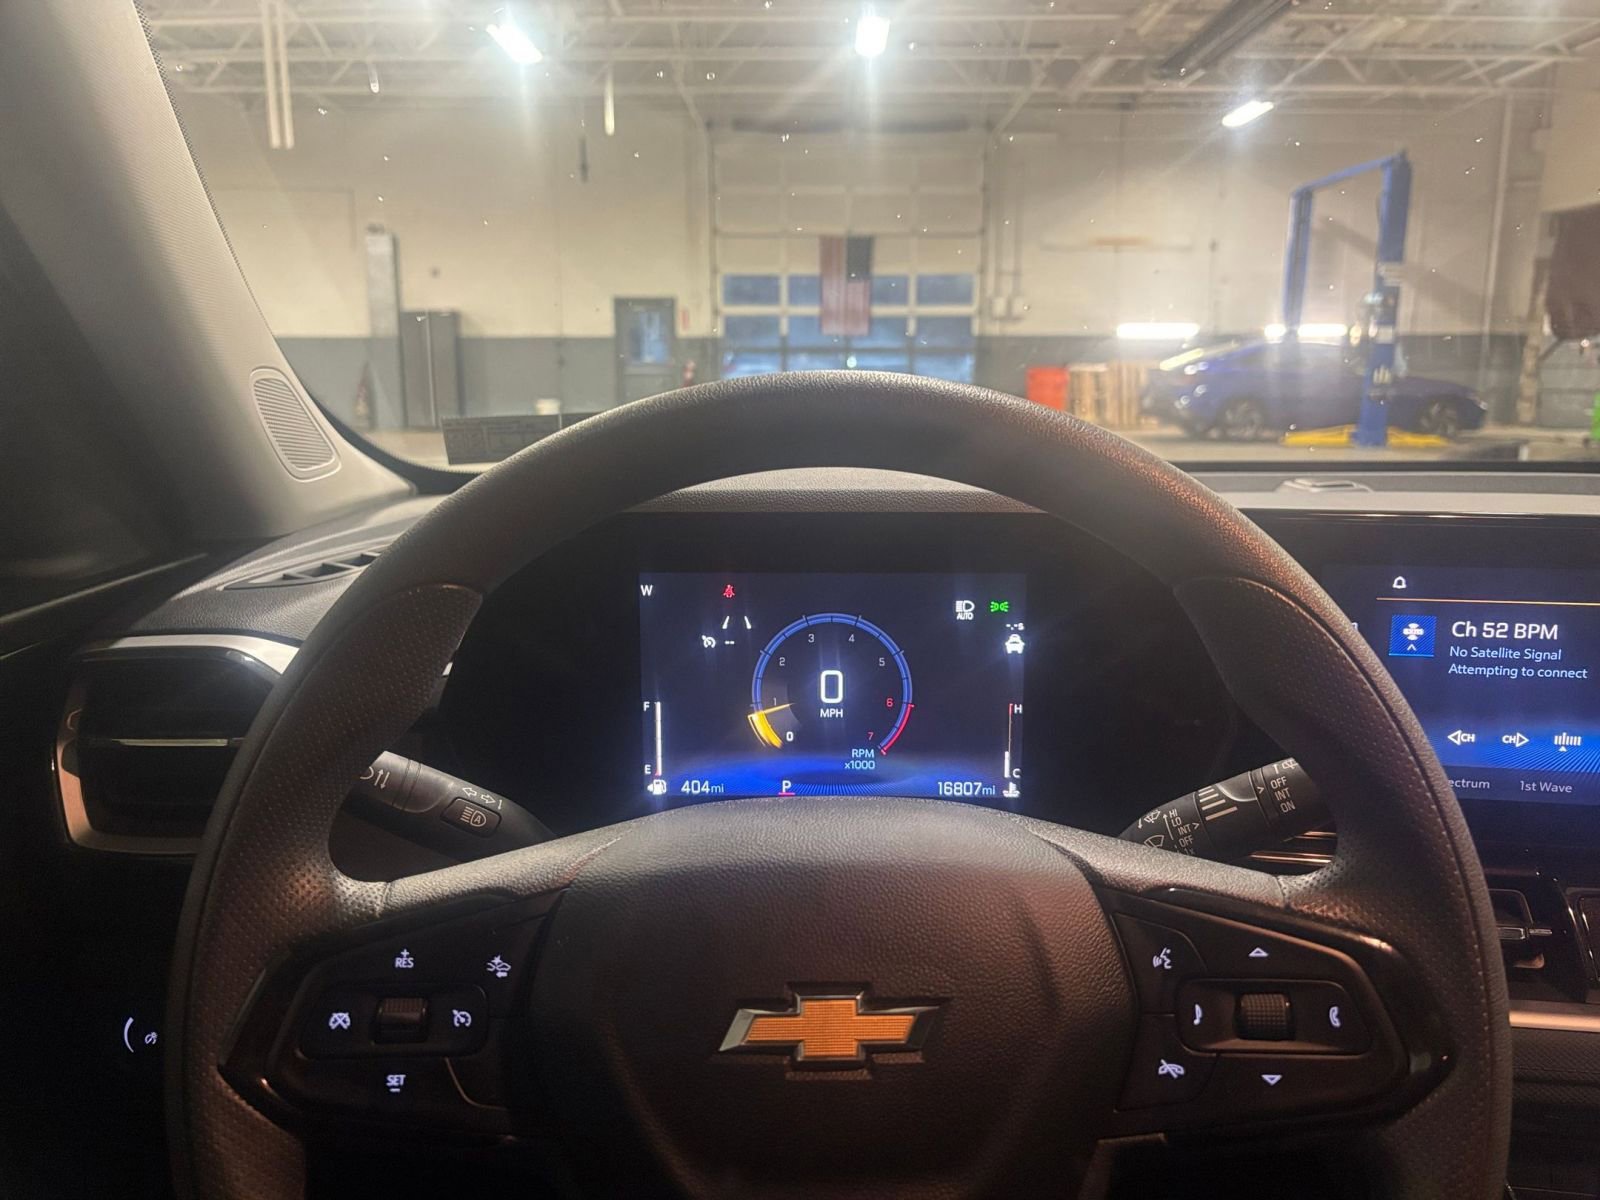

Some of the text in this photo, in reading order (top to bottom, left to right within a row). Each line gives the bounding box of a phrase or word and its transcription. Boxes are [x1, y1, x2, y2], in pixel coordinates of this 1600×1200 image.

[640, 584, 653, 597] W
[956, 612, 974, 621] AUTO
[1451, 620, 1559, 640] Ch 52 BPM
[807, 633, 815, 643] 3
[848, 633, 856, 643] 4
[1449, 645, 1562, 662] No Satellite Signal
[778, 656, 786, 667] 2
[878, 657, 886, 667] 5
[1448, 663, 1589, 679] Attempting to connect
[820, 669, 844, 704] 0
[643, 701, 651, 712] F
[886, 697, 894, 707] 6
[819, 708, 844, 718] MPH
[1013, 703, 1023, 715] H
[785, 731, 794, 742] 0
[867, 731, 874, 741] 7
[1460, 733, 1476, 743] CH
[1501, 735, 1517, 744] CH
[851, 748, 875, 758] RPM
[644, 764, 652, 775] E
[844, 760, 876, 770] x1000
[1012, 767, 1021, 779] C
[781, 780, 792, 794] P
[1270, 775, 1288, 790] OFF
[1520, 780, 1573, 793] 1st Wave
[1274, 787, 1291, 801] INT
[1280, 799, 1296, 813] ON
[1169, 808, 1178, 819] HI
[1171, 816, 1182, 828] LO
[1177, 823, 1191, 836] INT
[1178, 834, 1194, 848] OFF
[394, 956, 415, 969] RES
[385, 1074, 407, 1087] SET
